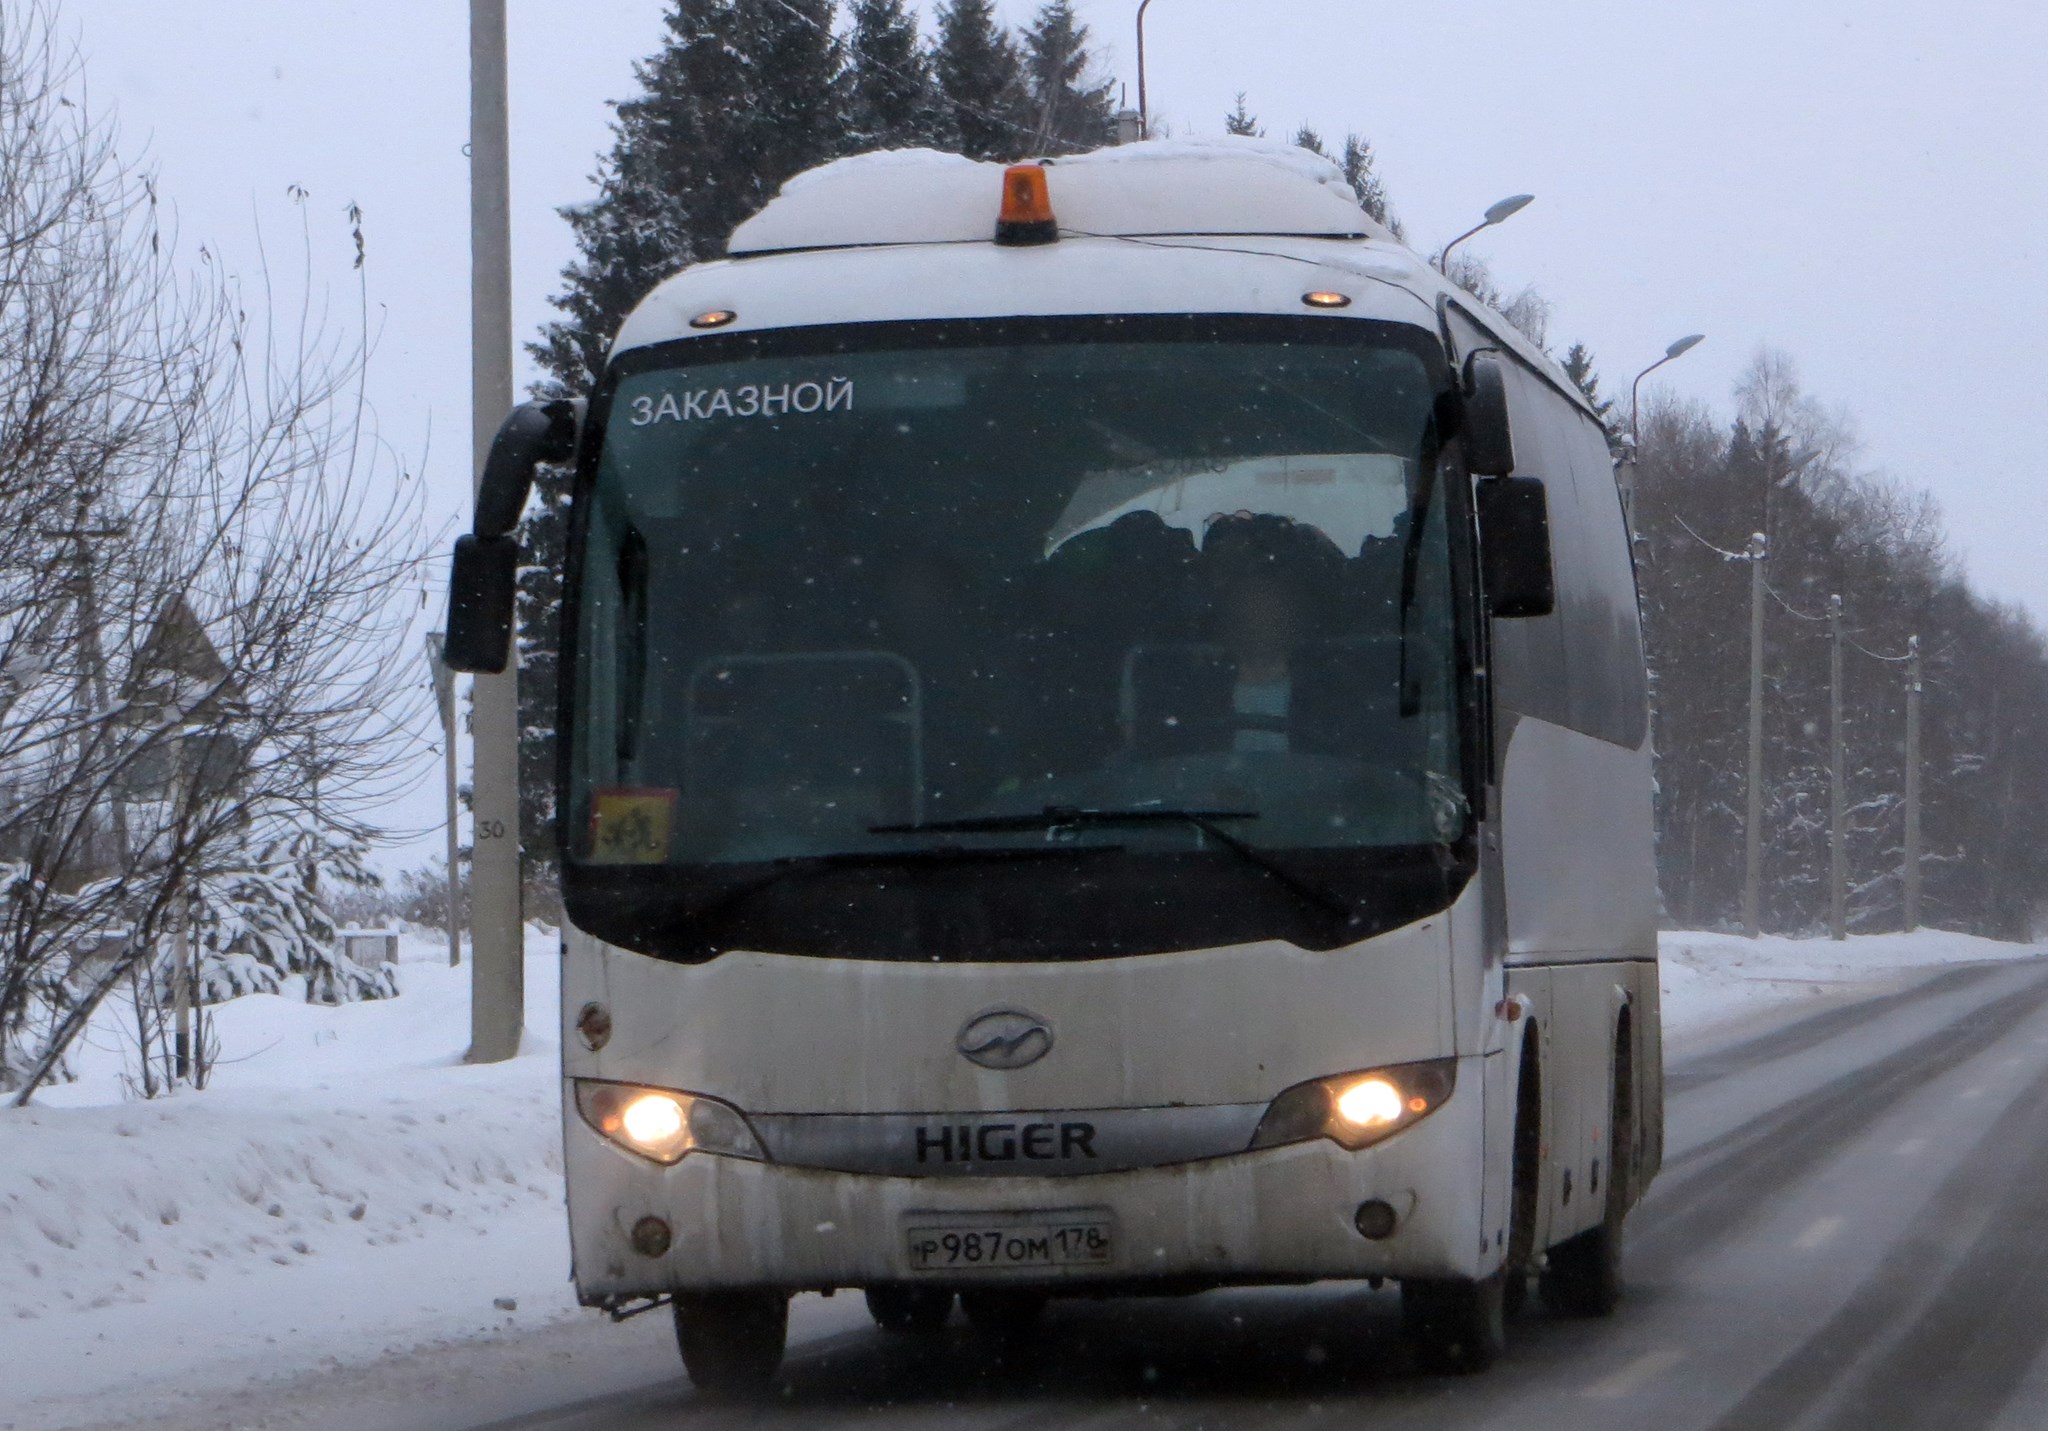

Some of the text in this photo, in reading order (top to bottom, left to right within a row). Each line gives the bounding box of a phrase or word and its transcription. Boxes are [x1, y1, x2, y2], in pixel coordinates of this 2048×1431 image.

[630, 376, 854, 426] ЗАКАЗНОЙ
[479, 820, 504, 839] 30
[915, 1122, 1097, 1163] HIGER
